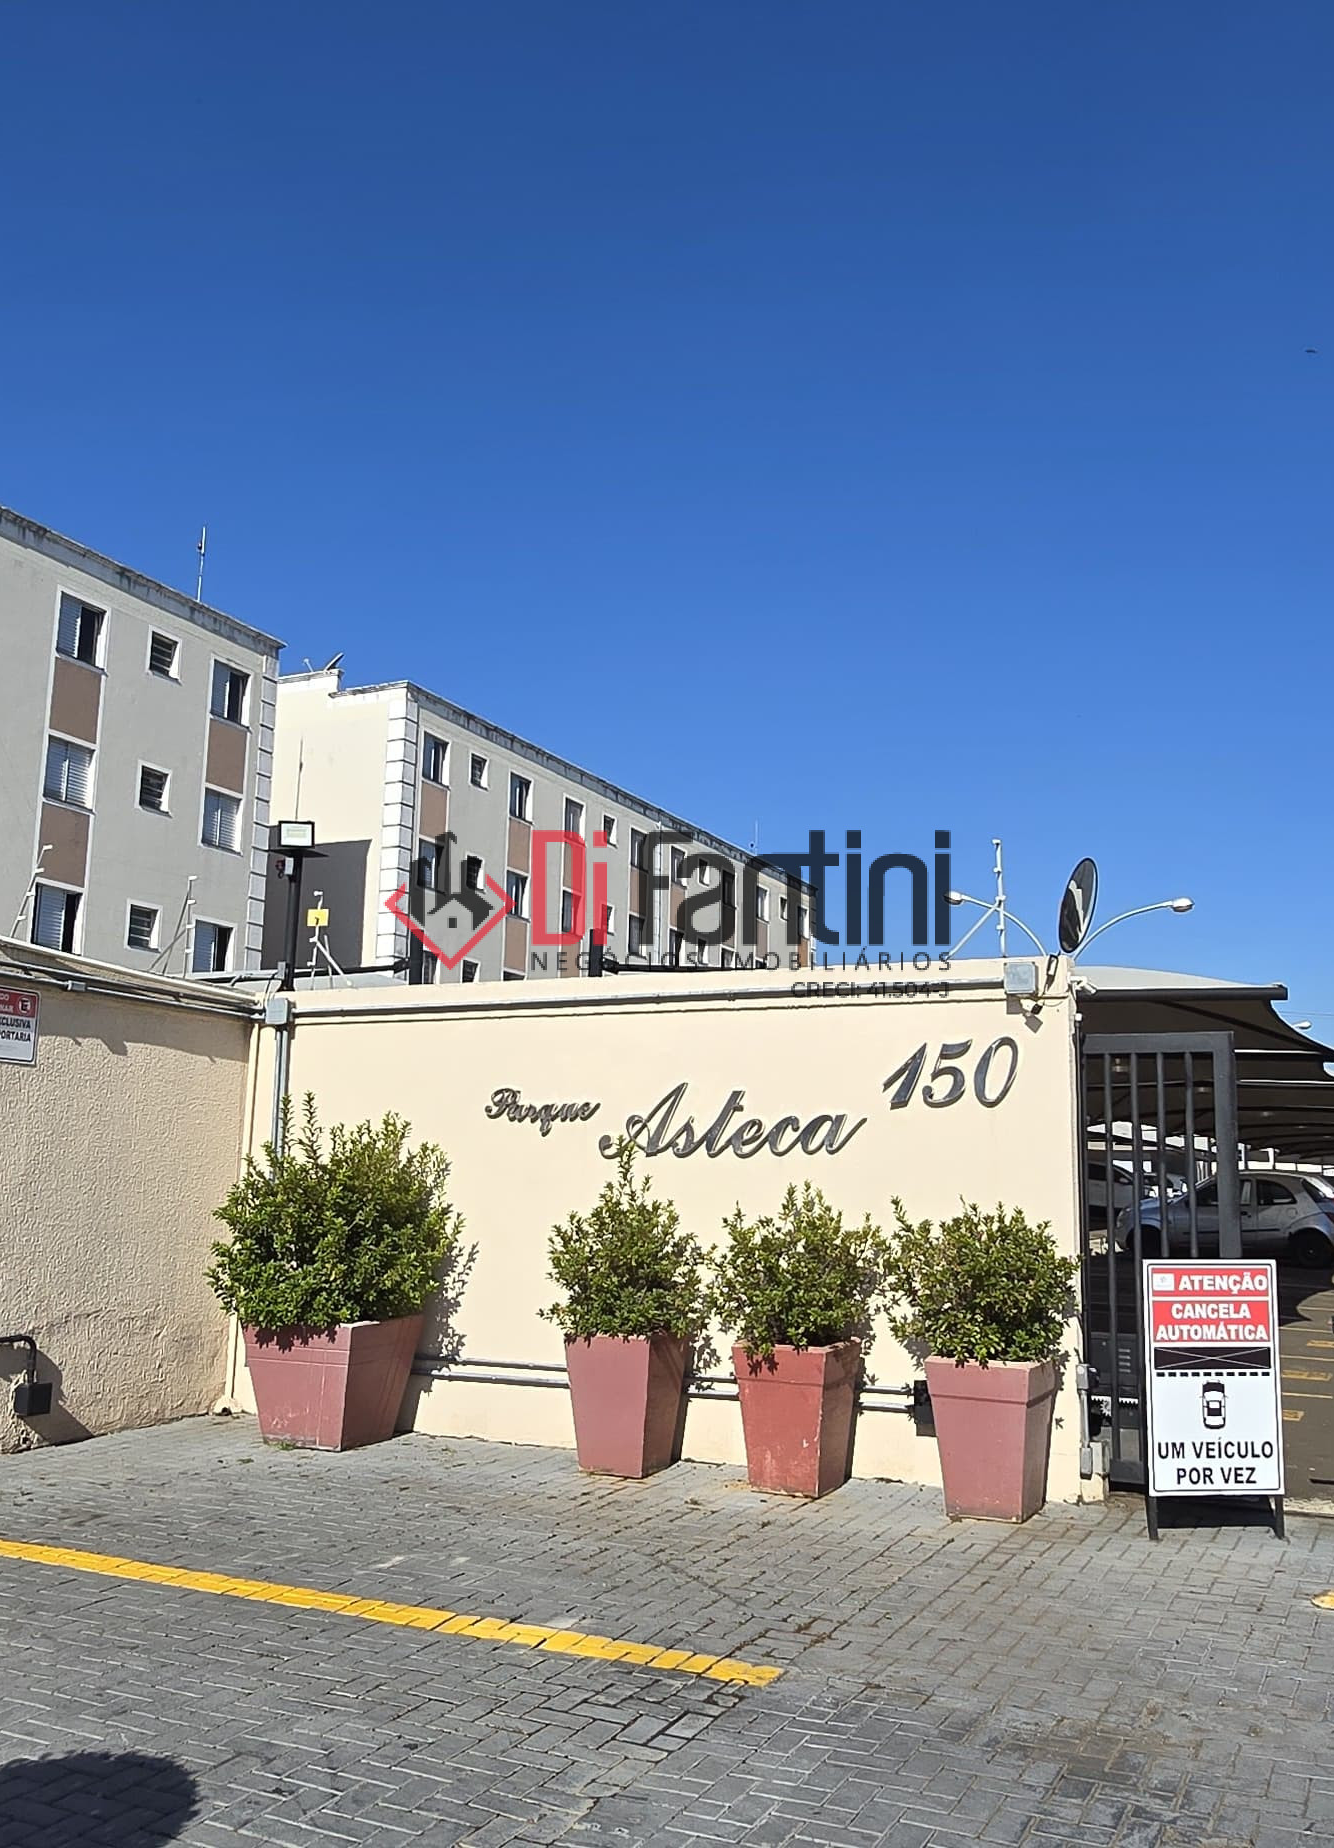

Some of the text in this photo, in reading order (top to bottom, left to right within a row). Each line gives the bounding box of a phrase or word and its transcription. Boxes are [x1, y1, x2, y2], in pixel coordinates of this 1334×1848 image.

[882, 1036, 1019, 1110] 150
[484, 1082, 867, 1159] Parque Asteca
[1178, 1271, 1268, 1295] ATENÇÃO
[1170, 1303, 1252, 1319] CANCELA
[1155, 1320, 1269, 1341] AUTOMÁTICA
[1157, 1437, 1274, 1459] UM VEÍCULO
[1176, 1468, 1257, 1485] POR VEZ
